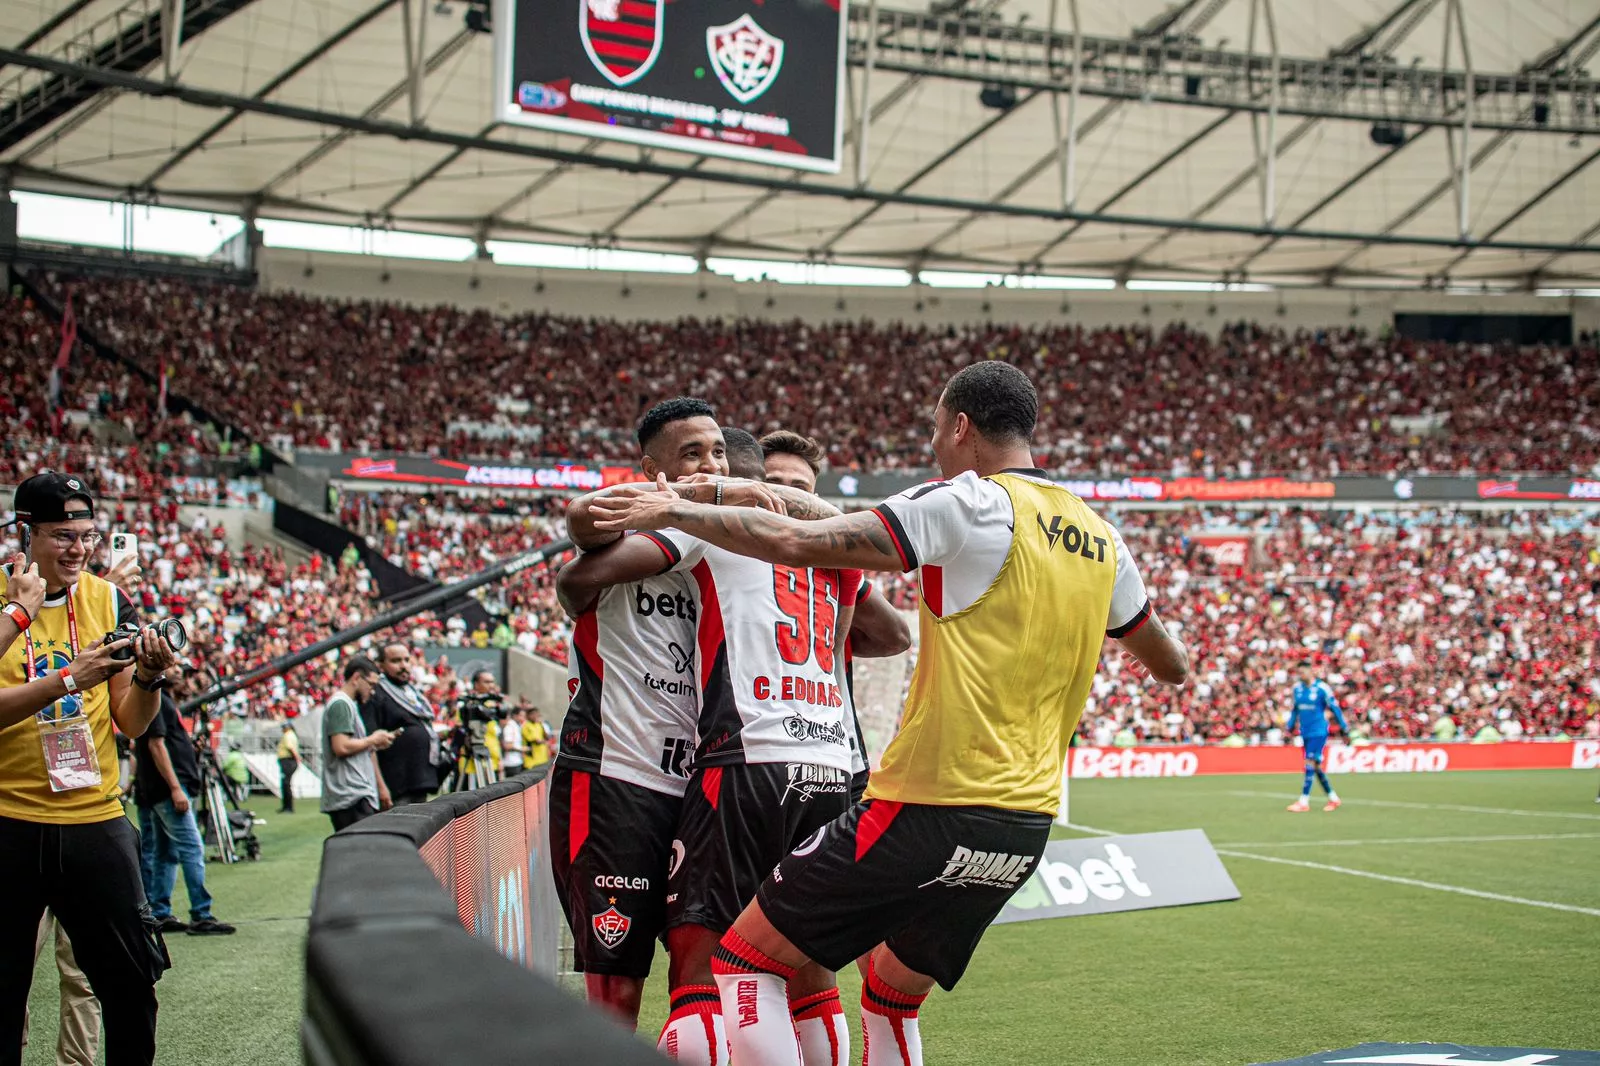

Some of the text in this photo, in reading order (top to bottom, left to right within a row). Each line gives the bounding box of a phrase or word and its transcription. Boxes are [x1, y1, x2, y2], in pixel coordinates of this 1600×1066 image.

[1037, 511, 1107, 563] VOLT
[772, 564, 839, 675] 96
[753, 675, 777, 701] C.
[1071, 748, 1198, 778] Betano
[1325, 745, 1449, 774] Betano
[942, 845, 1034, 883] PRIME
[594, 875, 649, 891] acelen
